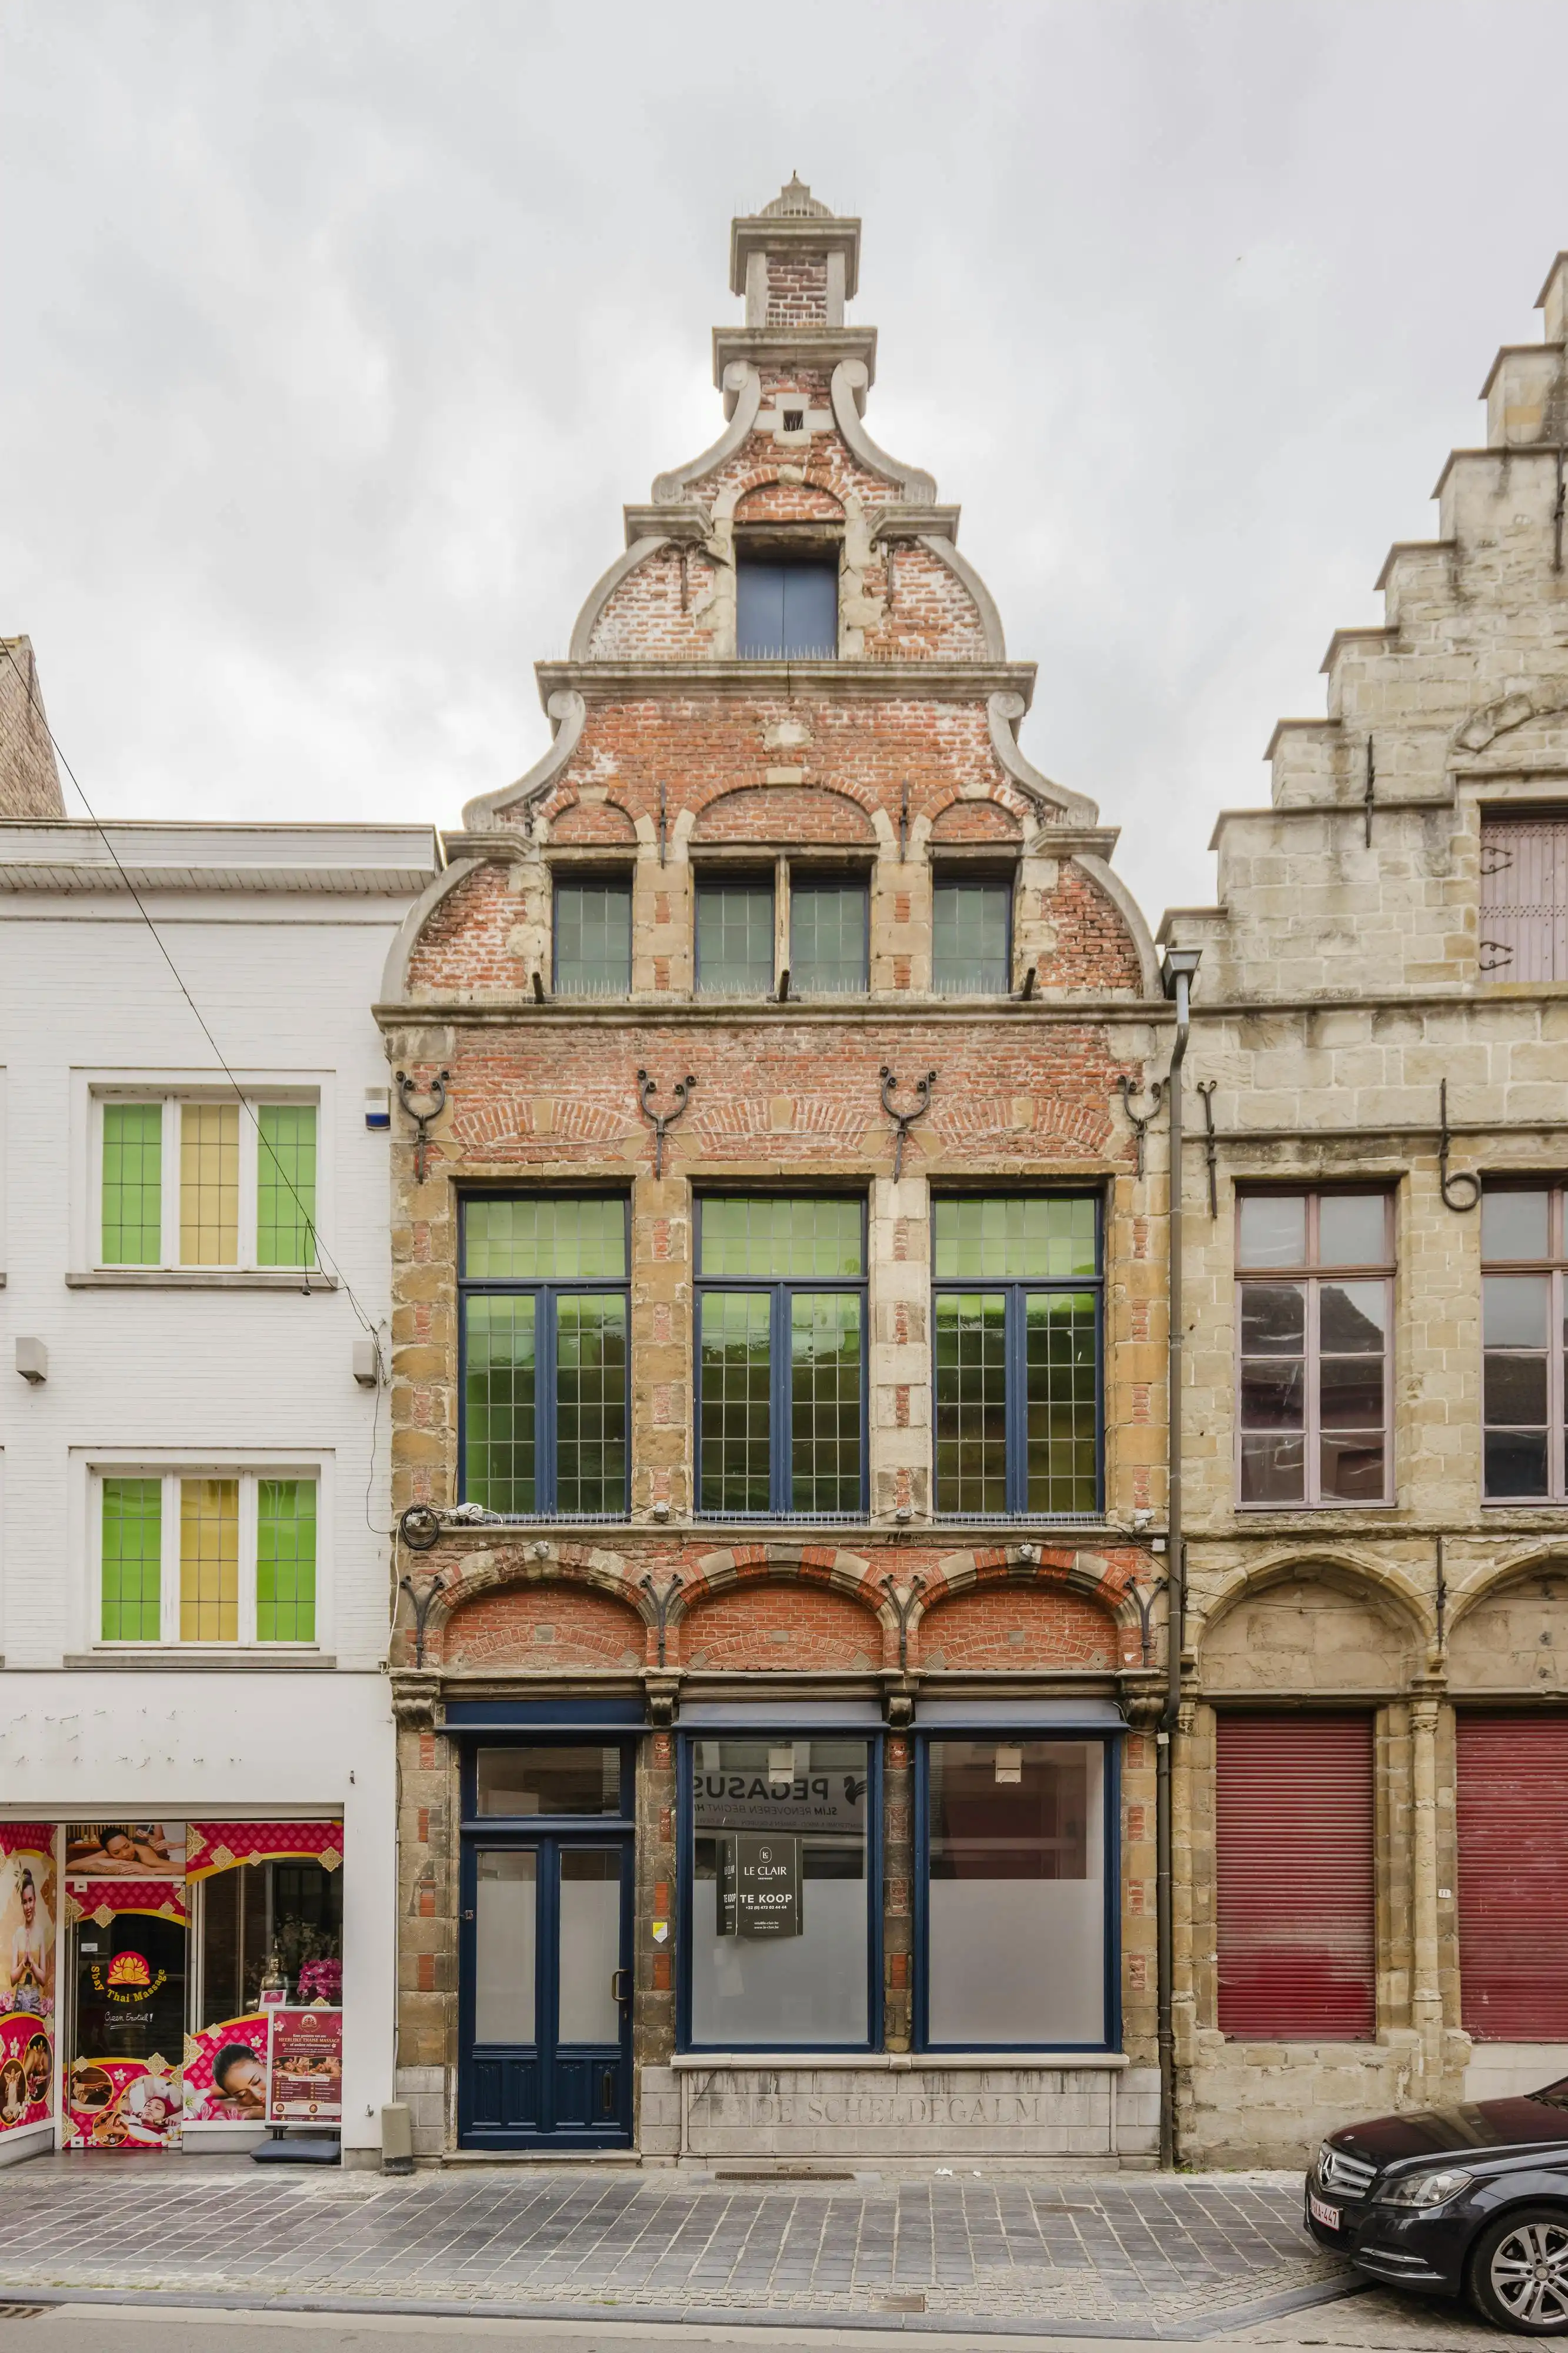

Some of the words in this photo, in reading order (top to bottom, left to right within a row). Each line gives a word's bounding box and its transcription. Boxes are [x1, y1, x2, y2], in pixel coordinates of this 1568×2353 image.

[744, 1867, 755, 1875] LE
[758, 1867, 787, 1875] CLAIR
[739, 1894, 755, 1903] TE
[759, 1894, 792, 1903] KOOP
[91, 1966, 105, 1991] Sbay
[106, 1988, 130, 2002] Thai
[133, 1969, 167, 2002] Massage
[756, 2098, 793, 2123] DE
[808, 2098, 1040, 2123] SCHELDEGALM
